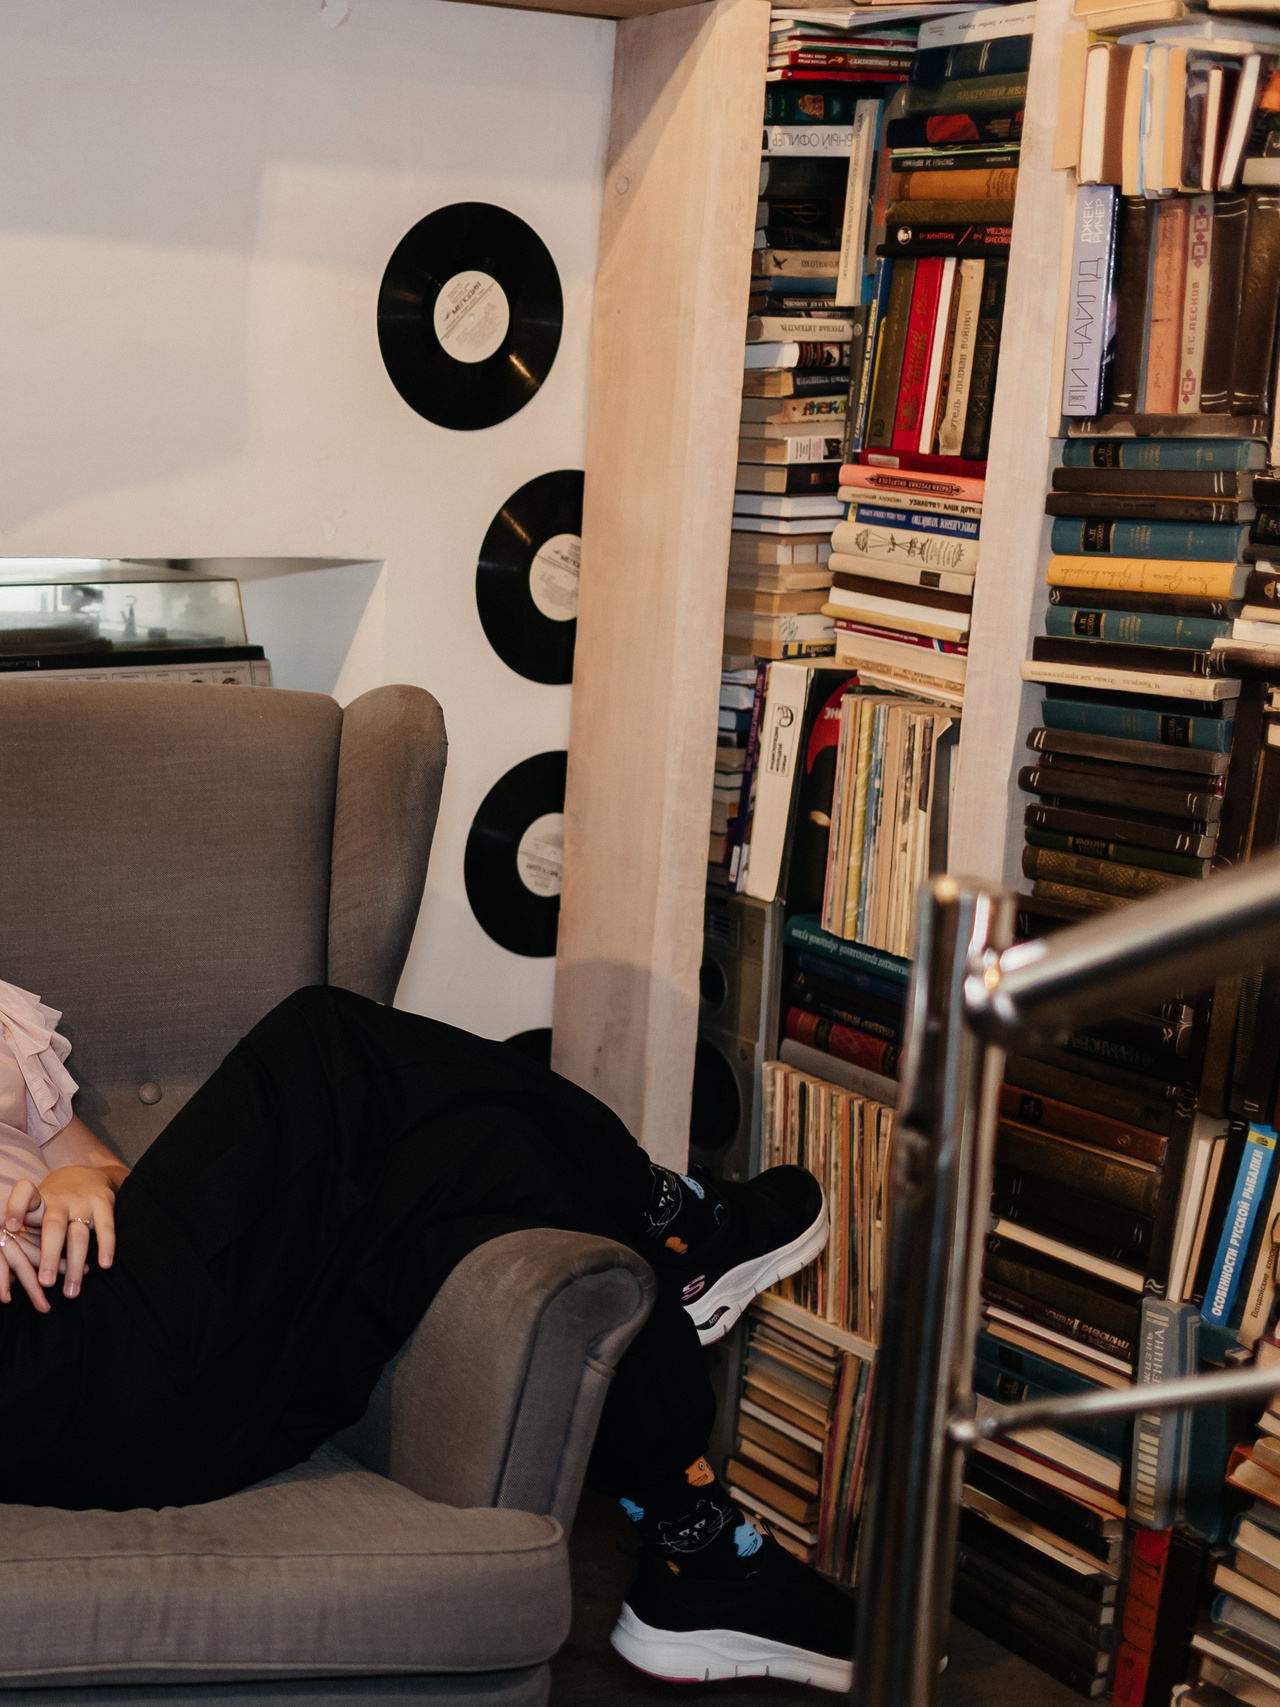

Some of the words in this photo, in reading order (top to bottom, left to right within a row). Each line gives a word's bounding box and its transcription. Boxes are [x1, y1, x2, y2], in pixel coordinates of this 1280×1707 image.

[771, 131, 820, 147] ОФИЦЕР
[1081, 200, 1093, 243] ДЖЕК
[1092, 199, 1105, 243] РИЧЕР
[960, 308, 973, 349] войнич
[1072, 257, 1104, 360] ЧАЙЛД
[1068, 368, 1090, 410] ЛИ
[1211, 1247, 1239, 1317] ОСОБЕННОСТИ
[1230, 1201, 1251, 1250] РУССКОЙ
[1242, 1149, 1264, 1200] РЫБАЛКИ
[1251, 1272, 1270, 1319] Валдайские
[708, 1314, 720, 1326] Arch
[1144, 1332, 1154, 1384] ЖИЗНЬ
[1152, 1329, 1165, 1384] ЕНИНА
